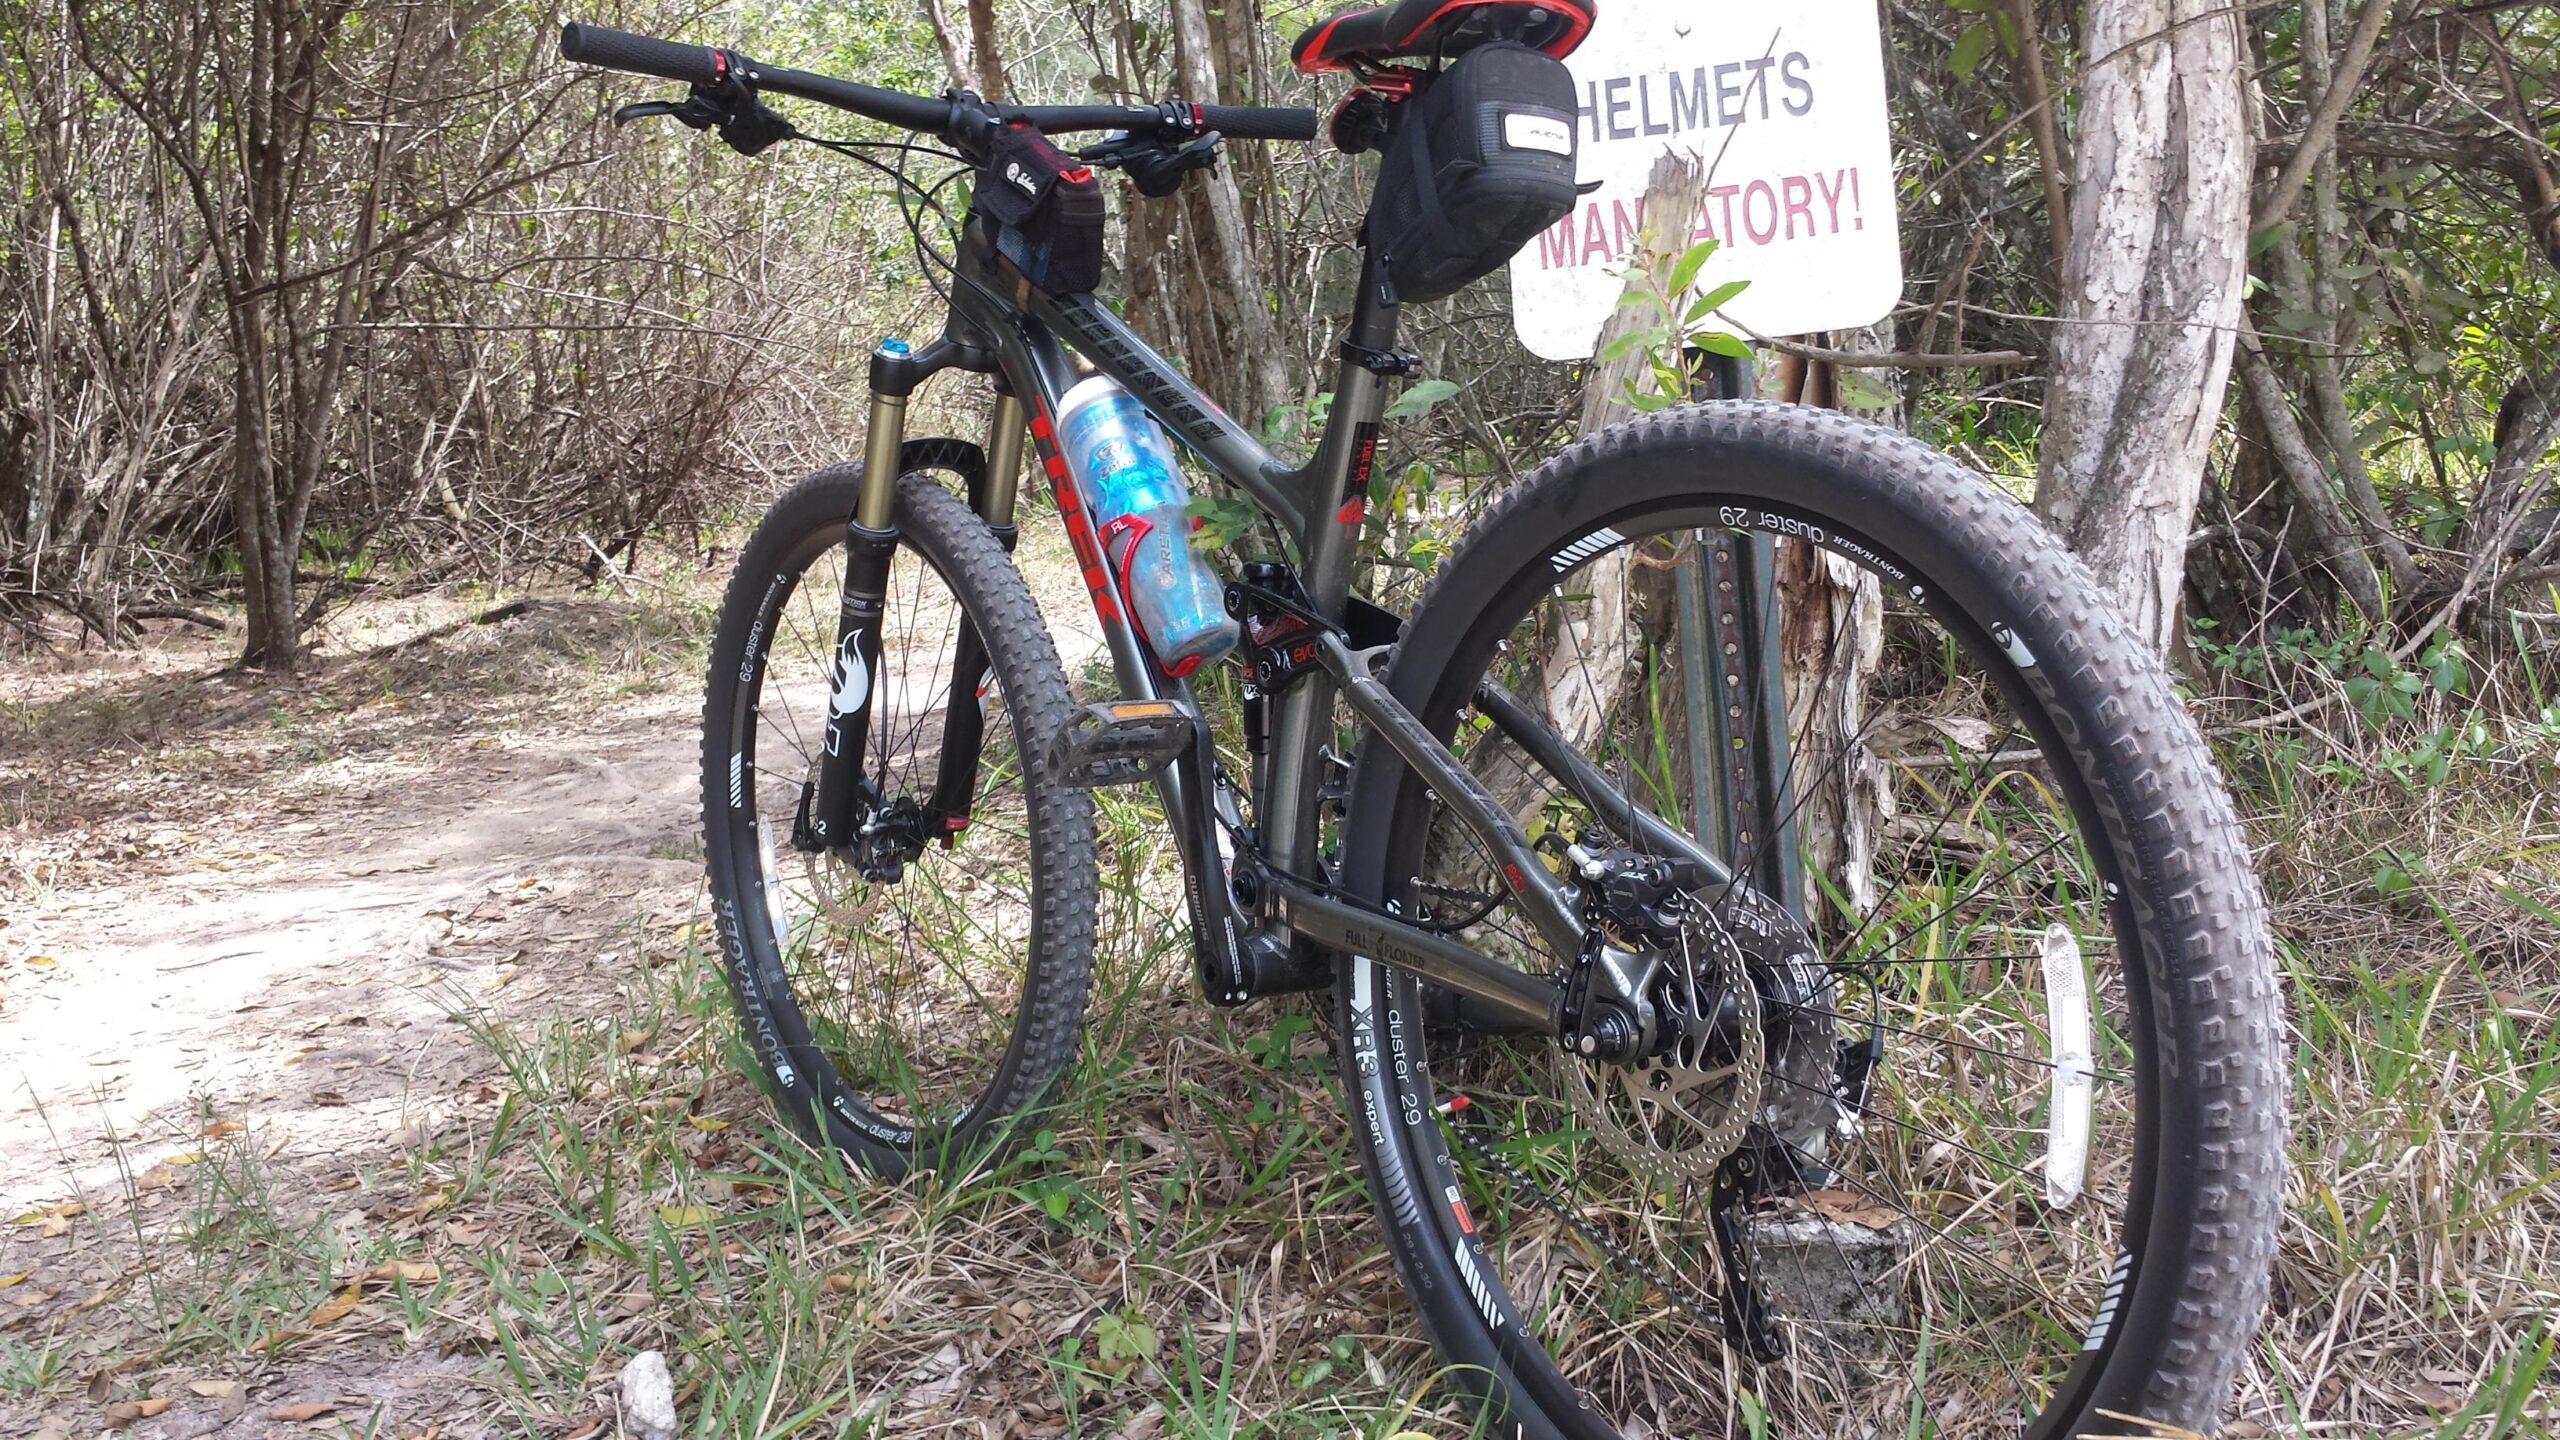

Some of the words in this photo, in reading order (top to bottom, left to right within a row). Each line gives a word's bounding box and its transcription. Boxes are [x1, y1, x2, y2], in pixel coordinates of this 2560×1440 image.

[1538, 167, 1863, 270] MANATORY!
[1030, 394, 1123, 626] TREK
[1719, 506, 1749, 528] 29
[1757, 512, 1824, 543] duster
[1833, 535, 1905, 581] BONTRAGER
[745, 621, 763, 660] duster
[739, 662, 753, 682] 29
[2024, 664, 2180, 1080] BONTRAGER
[1190, 875, 1209, 941] SHIMANO
[1345, 929, 1368, 950] FULL
[1384, 943, 1425, 970] FLOATER
[720, 898, 786, 1067] BONTRAGER
[1350, 1005, 1380, 1080] XR3
[1388, 1009, 1410, 1085] duster
[1401, 1093, 1422, 1126] 29
[868, 1124, 898, 1141] duster
[896, 1131, 912, 1143] 29
[1363, 1089, 1386, 1147] expert
[1403, 1232, 1415, 1249] 29
[1415, 1262, 1432, 1289] 2.30
